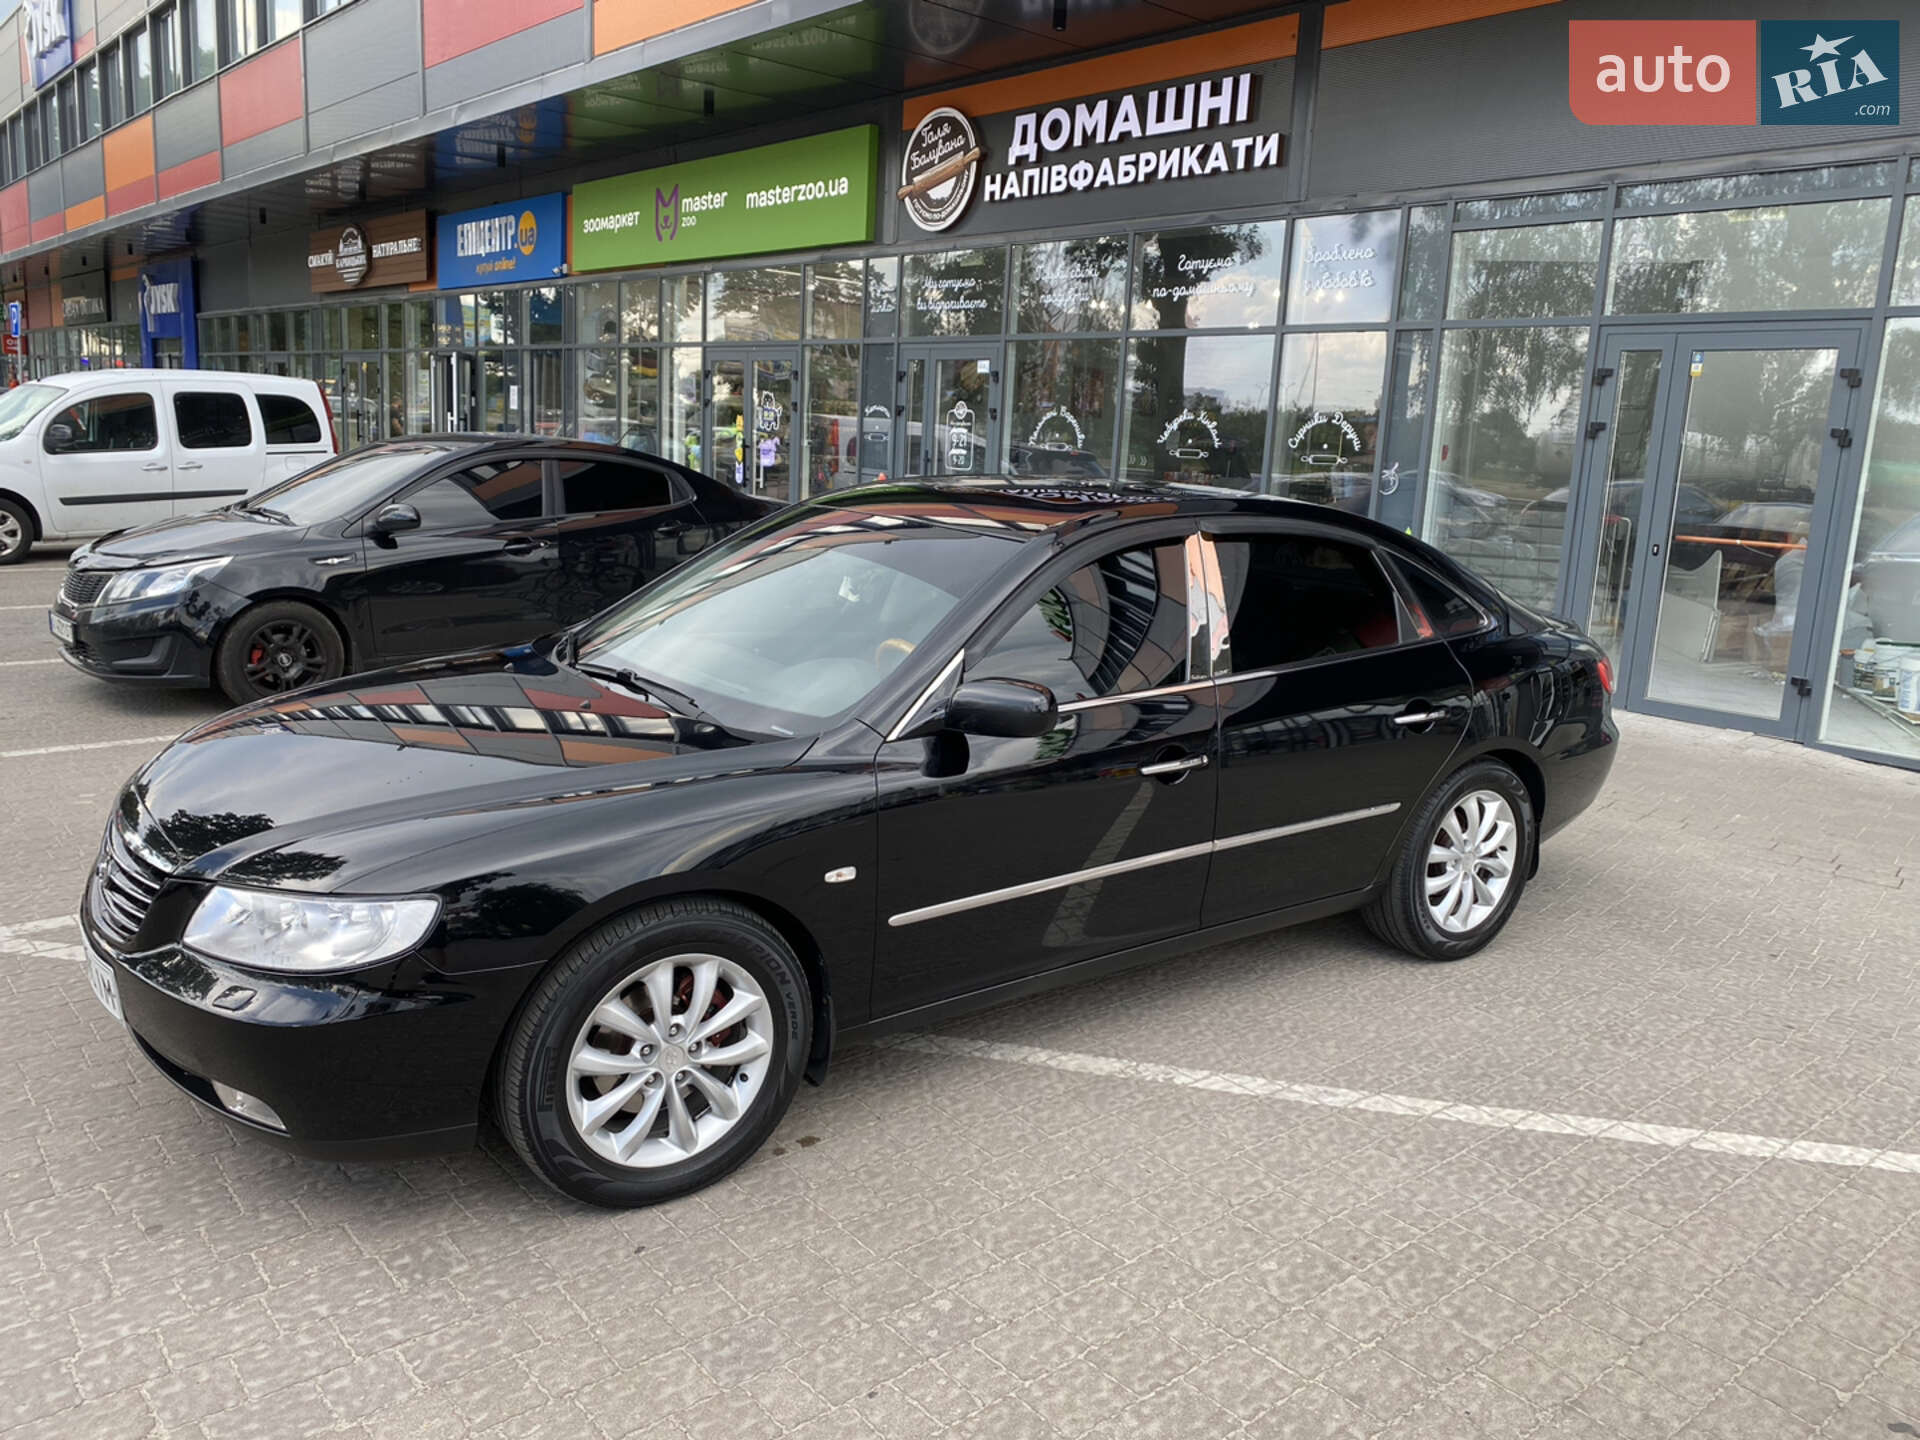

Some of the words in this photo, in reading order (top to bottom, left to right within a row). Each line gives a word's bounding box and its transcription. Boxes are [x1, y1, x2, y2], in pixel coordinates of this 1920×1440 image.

[920, 122, 952, 147] Галя
[1007, 73, 1251, 165] ДОМАШНІ
[910, 135, 966, 170] Балувана
[983, 132, 1280, 202] НАПІВФАБРИКАТИ
[681, 190, 729, 214] master
[745, 176, 849, 210] masterzoo.ua
[582, 210, 641, 234] зоомаркет
[681, 216, 697, 228] zoo
[1178, 254, 1233, 274] Готуємо
[150, 283, 179, 314] JYSK
[1288, 411, 1329, 449] Сирники
[785, 991, 799, 1040] VERDE
